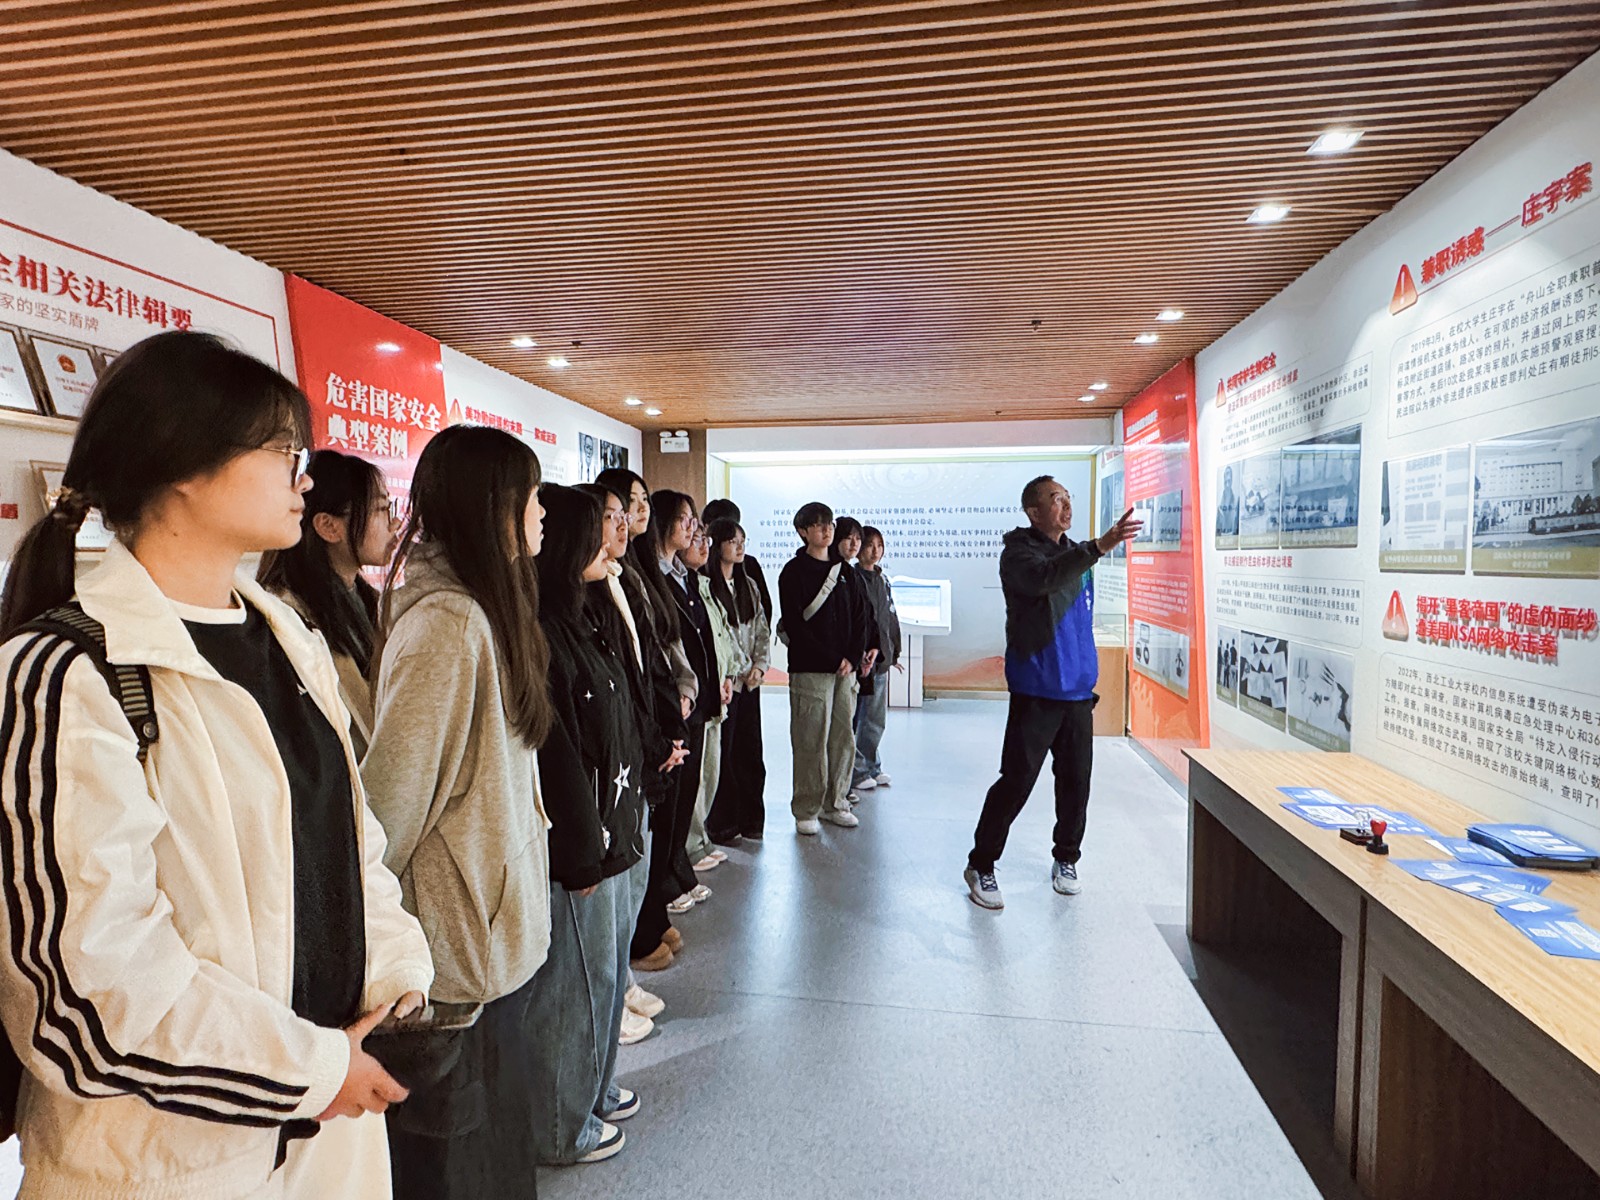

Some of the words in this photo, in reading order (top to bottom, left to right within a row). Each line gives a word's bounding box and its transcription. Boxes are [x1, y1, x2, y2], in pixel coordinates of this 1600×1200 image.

[325, 372, 441, 433] 危害国家安全
[327, 413, 408, 459] 典型案例
[1415, 618, 1558, 658] 遭美国NSA网络攻击案
